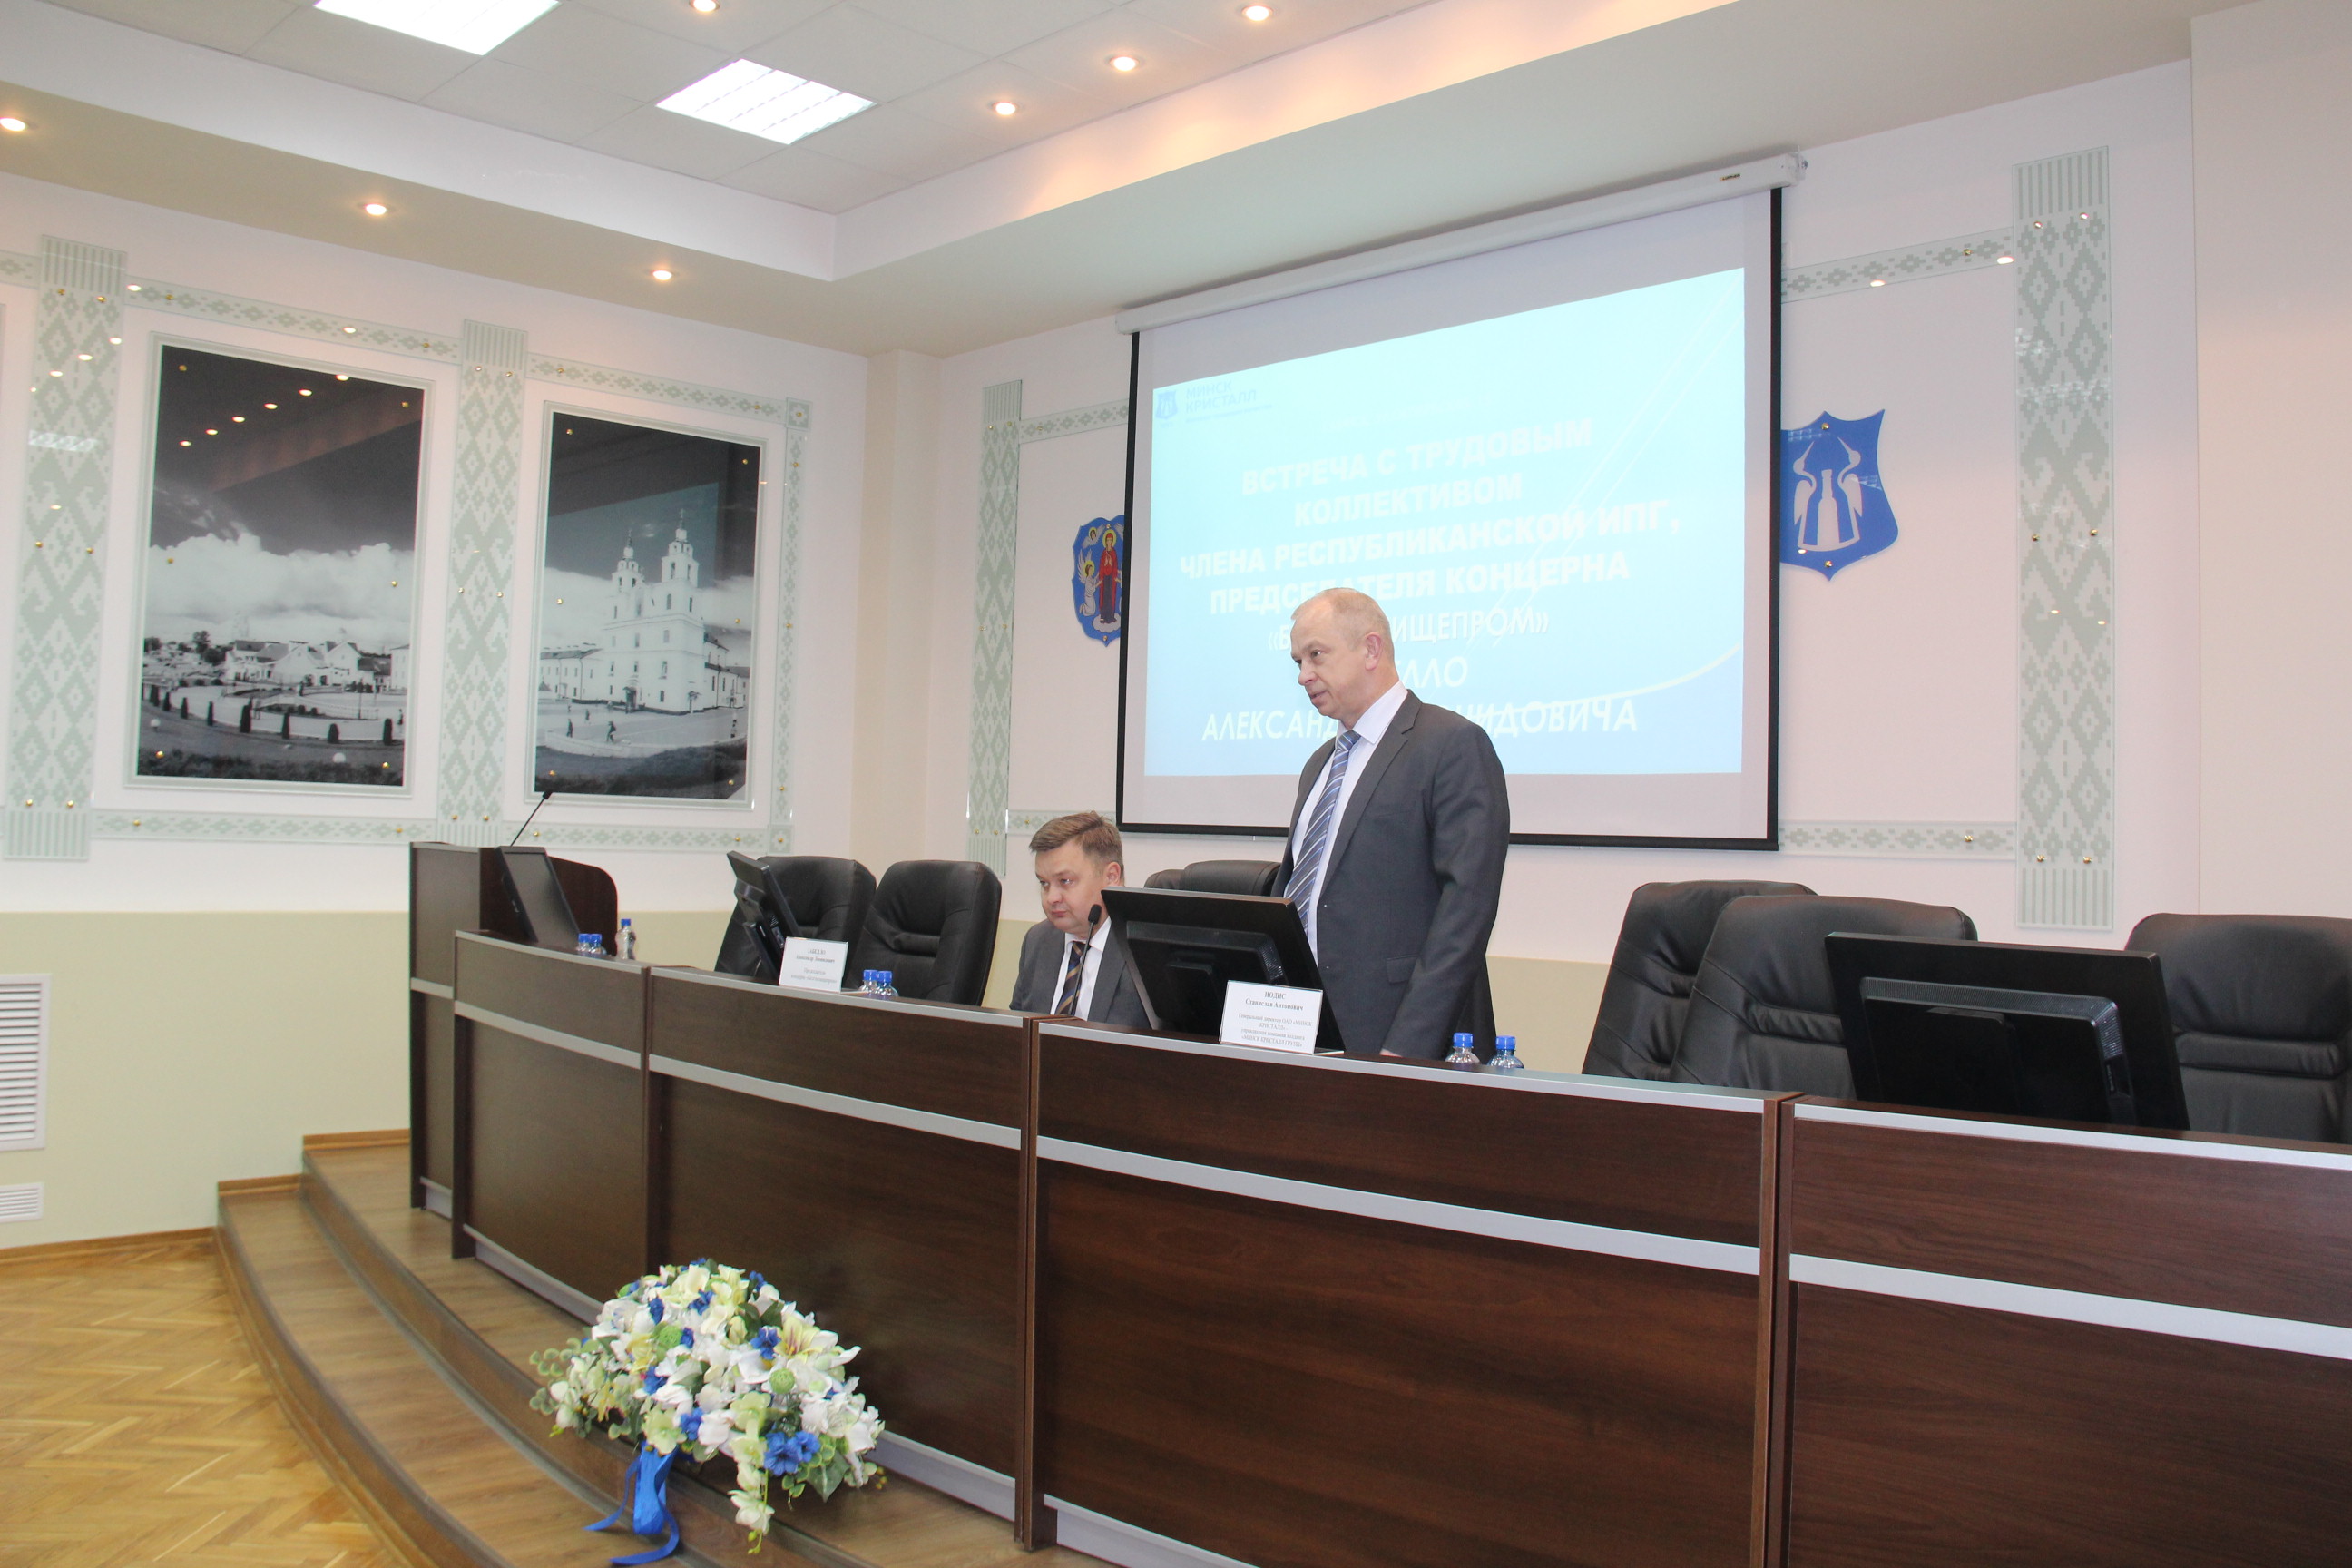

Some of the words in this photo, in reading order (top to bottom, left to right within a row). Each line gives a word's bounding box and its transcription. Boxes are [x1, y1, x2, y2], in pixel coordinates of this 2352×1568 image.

[1185, 380, 1232, 399] МИНСК
[1185, 389, 1257, 413] КРИСТАЛЛ
[1241, 453, 1367, 496] ВСТРЕЧА
[1378, 447, 1397, 475] С
[1406, 417, 1593, 473] ТРУДОВЫМ
[1294, 473, 1523, 527] КОЛЛЕКТИВОМ
[1181, 547, 1267, 580] ЧЛЕНА
[1274, 509, 1586, 570] РЕСПУБЛИКАНСКОЙ
[1597, 499, 1681, 536] ИПГ,
[1446, 551, 1631, 599] КОНЦЕРНА
[1245, 998, 1273, 1008] Станислав
[1274, 1002, 1304, 1011] Антонович
